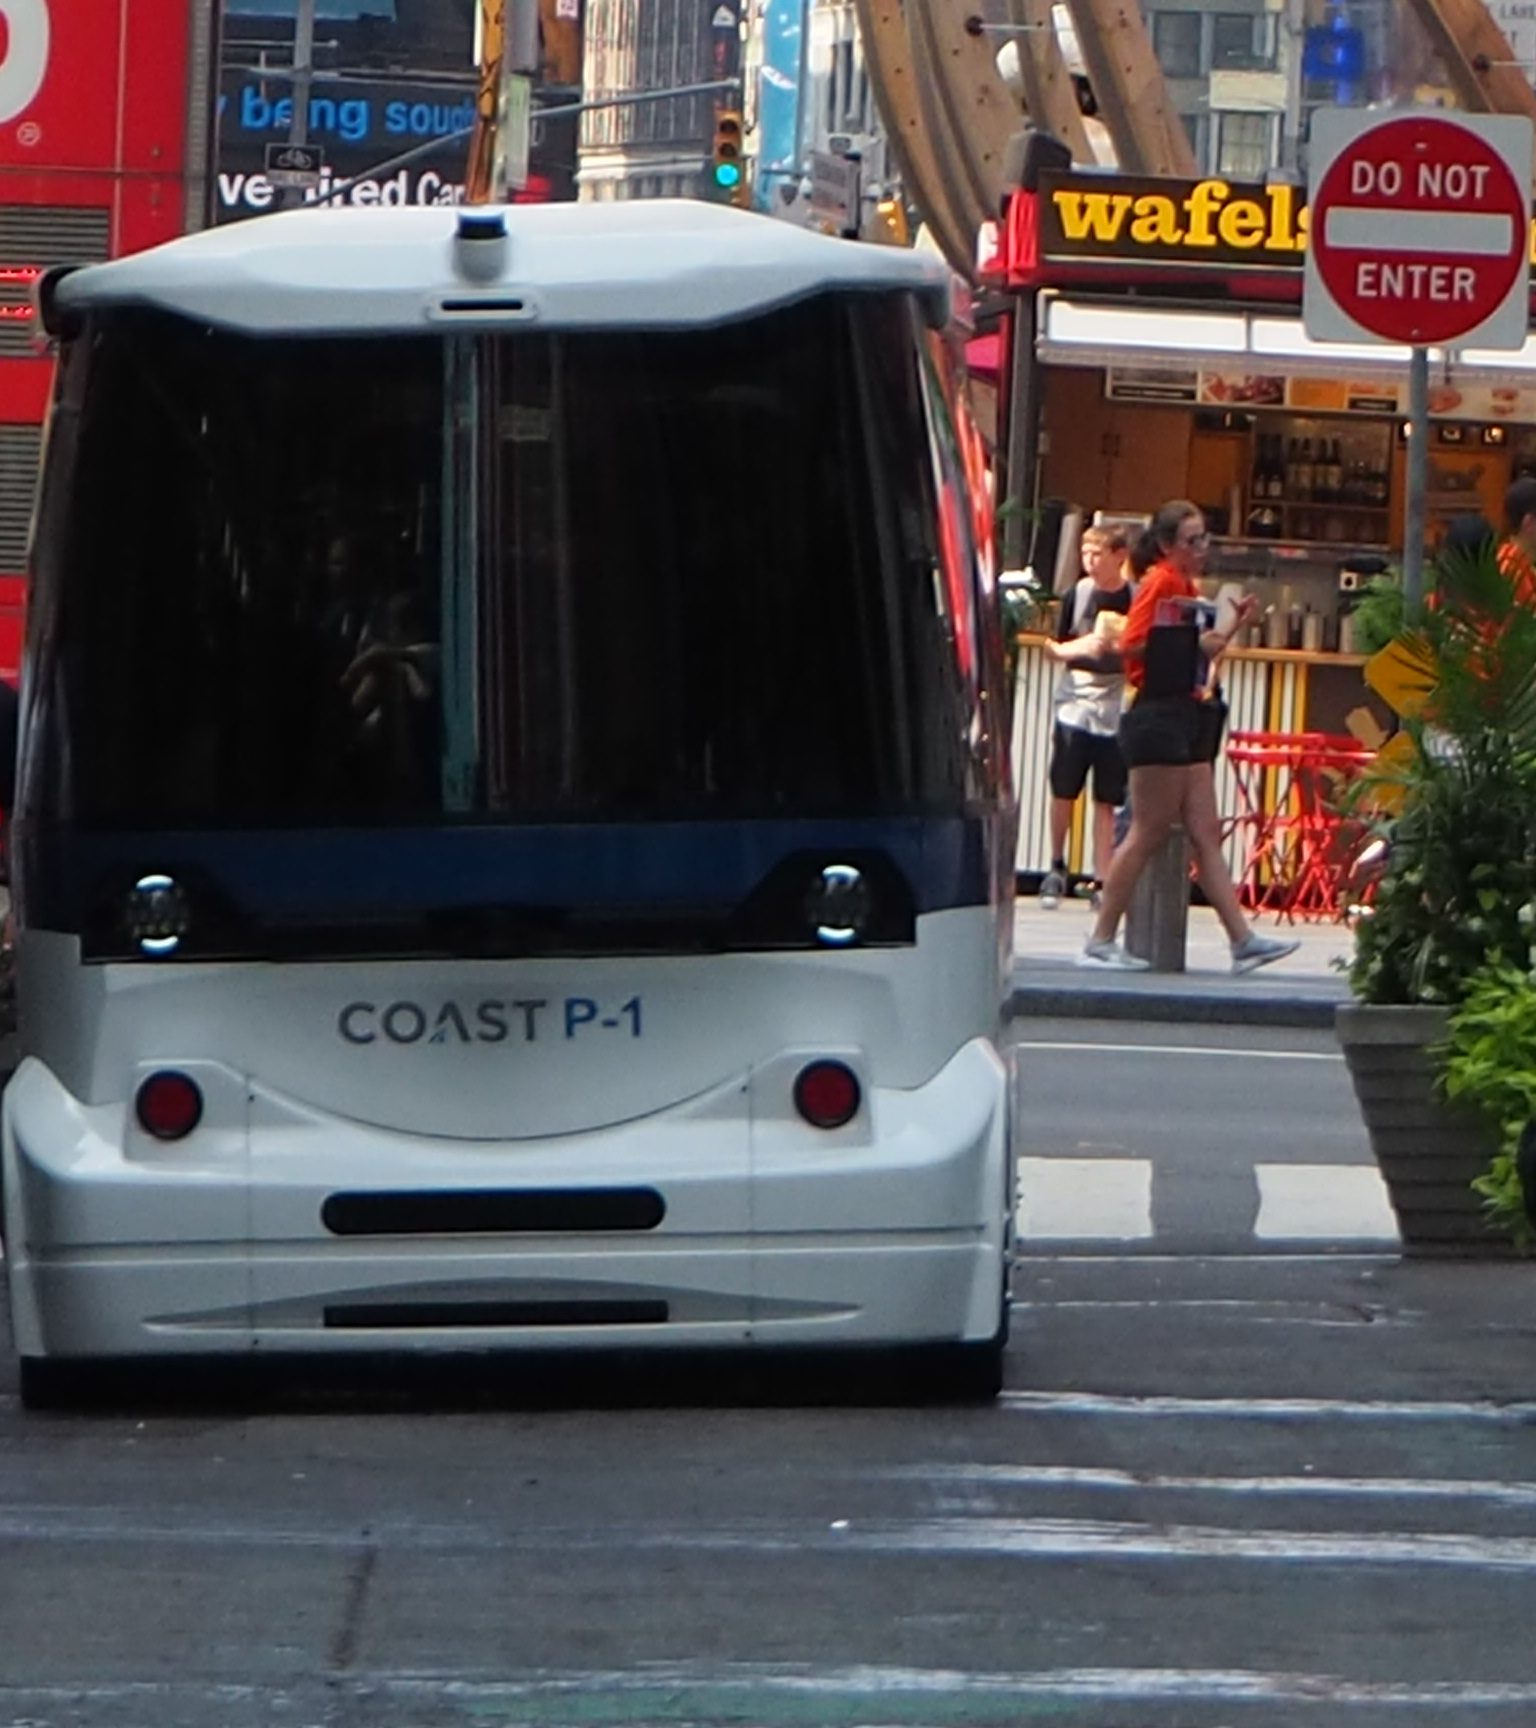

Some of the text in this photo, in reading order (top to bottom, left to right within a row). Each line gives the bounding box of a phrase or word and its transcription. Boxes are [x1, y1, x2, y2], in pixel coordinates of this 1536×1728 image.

[240, 86, 371, 141] beng
[1351, 162, 1490, 200] DO NOT
[1356, 264, 1476, 302] ENTER
[337, 996, 643, 1045] COAST P-1
